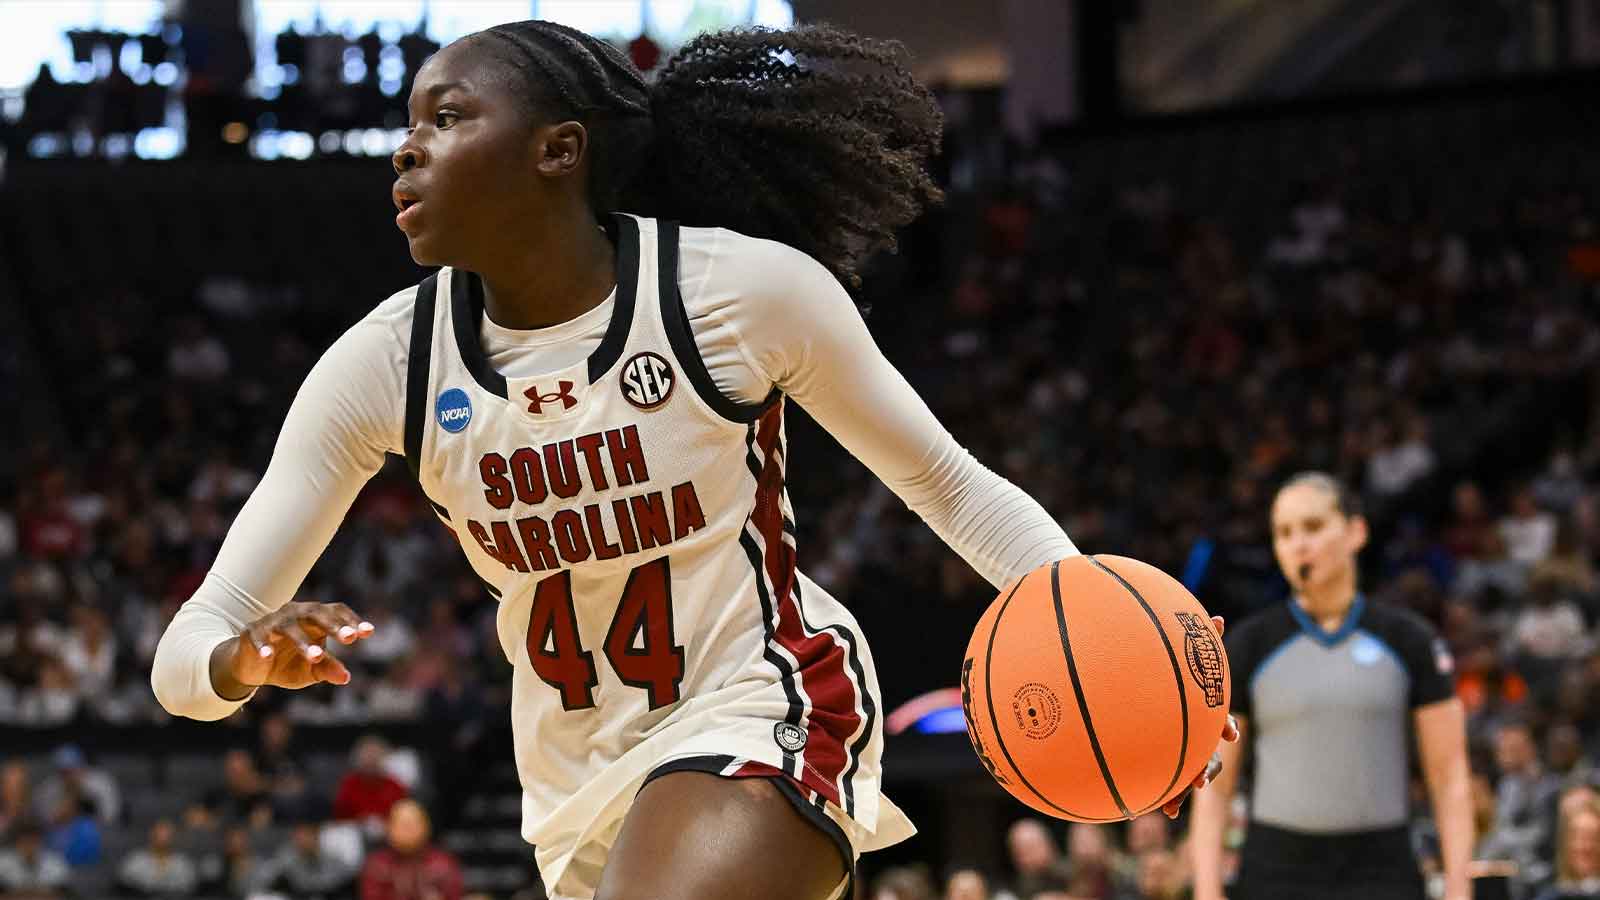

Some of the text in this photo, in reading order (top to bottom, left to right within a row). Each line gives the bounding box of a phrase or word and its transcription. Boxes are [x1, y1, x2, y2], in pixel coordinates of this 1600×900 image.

[440, 406, 470, 423] NCAA
[622, 355, 671, 404] SEC
[479, 424, 650, 509] SOUTH
[467, 480, 707, 573] CAROLINA
[526, 556, 685, 712] 44
[1199, 629, 1221, 680] MARCH
[1195, 636, 1217, 707] MADNESS
